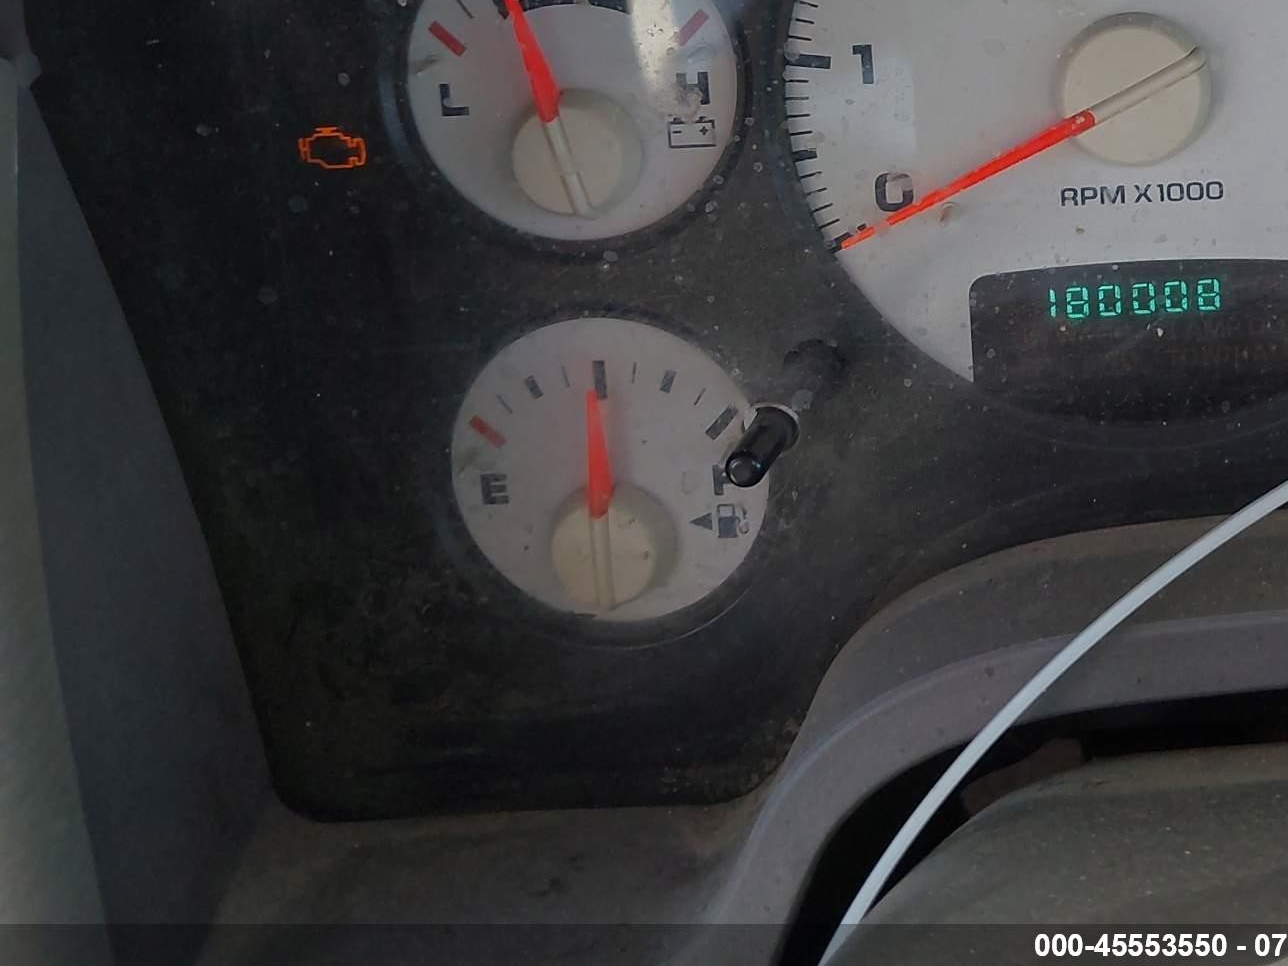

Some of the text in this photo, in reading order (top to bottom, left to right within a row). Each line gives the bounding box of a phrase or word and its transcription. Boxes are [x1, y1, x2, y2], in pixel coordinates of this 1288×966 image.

[853, 45, 874, 84] 1
[440, 84, 469, 116] L
[874, 172, 914, 212] 0
[1061, 185, 1125, 206] RPM
[1049, 279, 1220, 318] 180008
[480, 474, 509, 504] E
